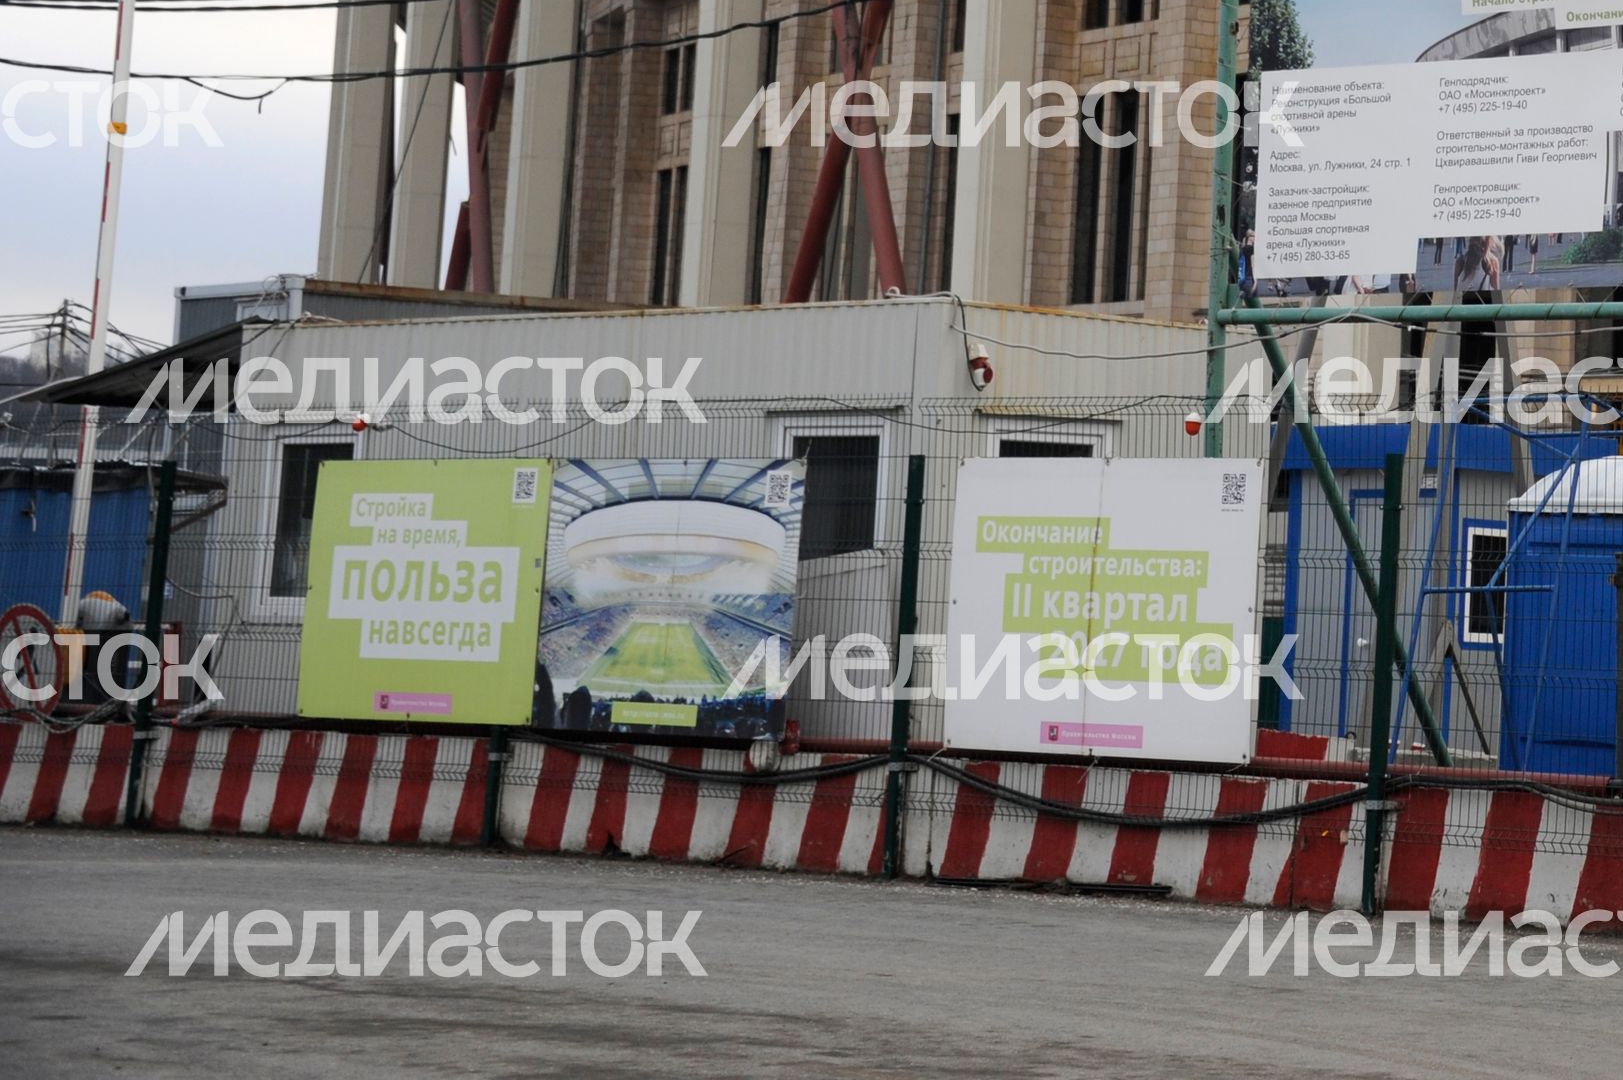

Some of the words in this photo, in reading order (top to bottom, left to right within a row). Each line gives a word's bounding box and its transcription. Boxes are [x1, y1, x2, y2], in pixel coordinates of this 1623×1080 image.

[1344, 81, 1385, 92] объекта:
[1440, 76, 1509, 88] Генподрядчик:
[1344, 94, 1391, 104] «Большой
[1439, 90, 1461, 100] ОАО
[1465, 88, 1546, 99] «Мосинжпроект»
[1438, 104, 1450, 113] +7
[1453, 103, 1477, 114] (495)
[1480, 100, 1527, 112] 225-19-40
[1327, 110, 1356, 119] арены
[1437, 128, 1510, 140] Ответственный
[1527, 125, 1593, 137] производство
[1436, 140, 1554, 155] строительно-монтажных
[1558, 137, 1588, 148] работ:
[1270, 150, 1300, 161] Адрес:
[1436, 156, 1513, 169] Цхвиравашвили
[1516, 154, 1538, 163] Гиви
[1542, 152, 1597, 163] Георгиевич
[1270, 163, 1306, 173] Москва,
[1309, 162, 1321, 173] ул.
[1325, 160, 1367, 172] Лужники,
[1371, 159, 1381, 168] 24
[1385, 159, 1402, 169] стр.
[1269, 185, 1370, 197] Заказчик-застройщик:
[1268, 200, 1309, 210] казенное
[1312, 198, 1372, 209] предприятие
[1433, 197, 1455, 207] ОАО
[1459, 196, 1540, 206] «Мосинжпроект»
[1268, 214, 1298, 224] города
[1300, 212, 1336, 221] Москвы
[1433, 212, 1444, 220] +7
[1447, 210, 1471, 222] (495)
[1474, 208, 1521, 219] 225-19-40
[1268, 226, 1312, 236] «Большая
[1316, 225, 1369, 235] спортивная
[1266, 241, 1293, 250] арена
[1296, 238, 1345, 249] «Лужники»
[1267, 253, 1277, 262] +7
[1280, 252, 1302, 264] (495)
[1305, 251, 1350, 261] 280-33-65
[356, 496, 427, 518] Стройка
[377, 528, 397, 543] на
[402, 526, 461, 549] время,
[982, 520, 1103, 544] Окончание
[1029, 554, 1201, 579] строительства:
[1012, 583, 1032, 617] II
[1043, 591, 1188, 628] квартал
[369, 619, 491, 652] навсегда
[1141, 637, 1222, 678] года
